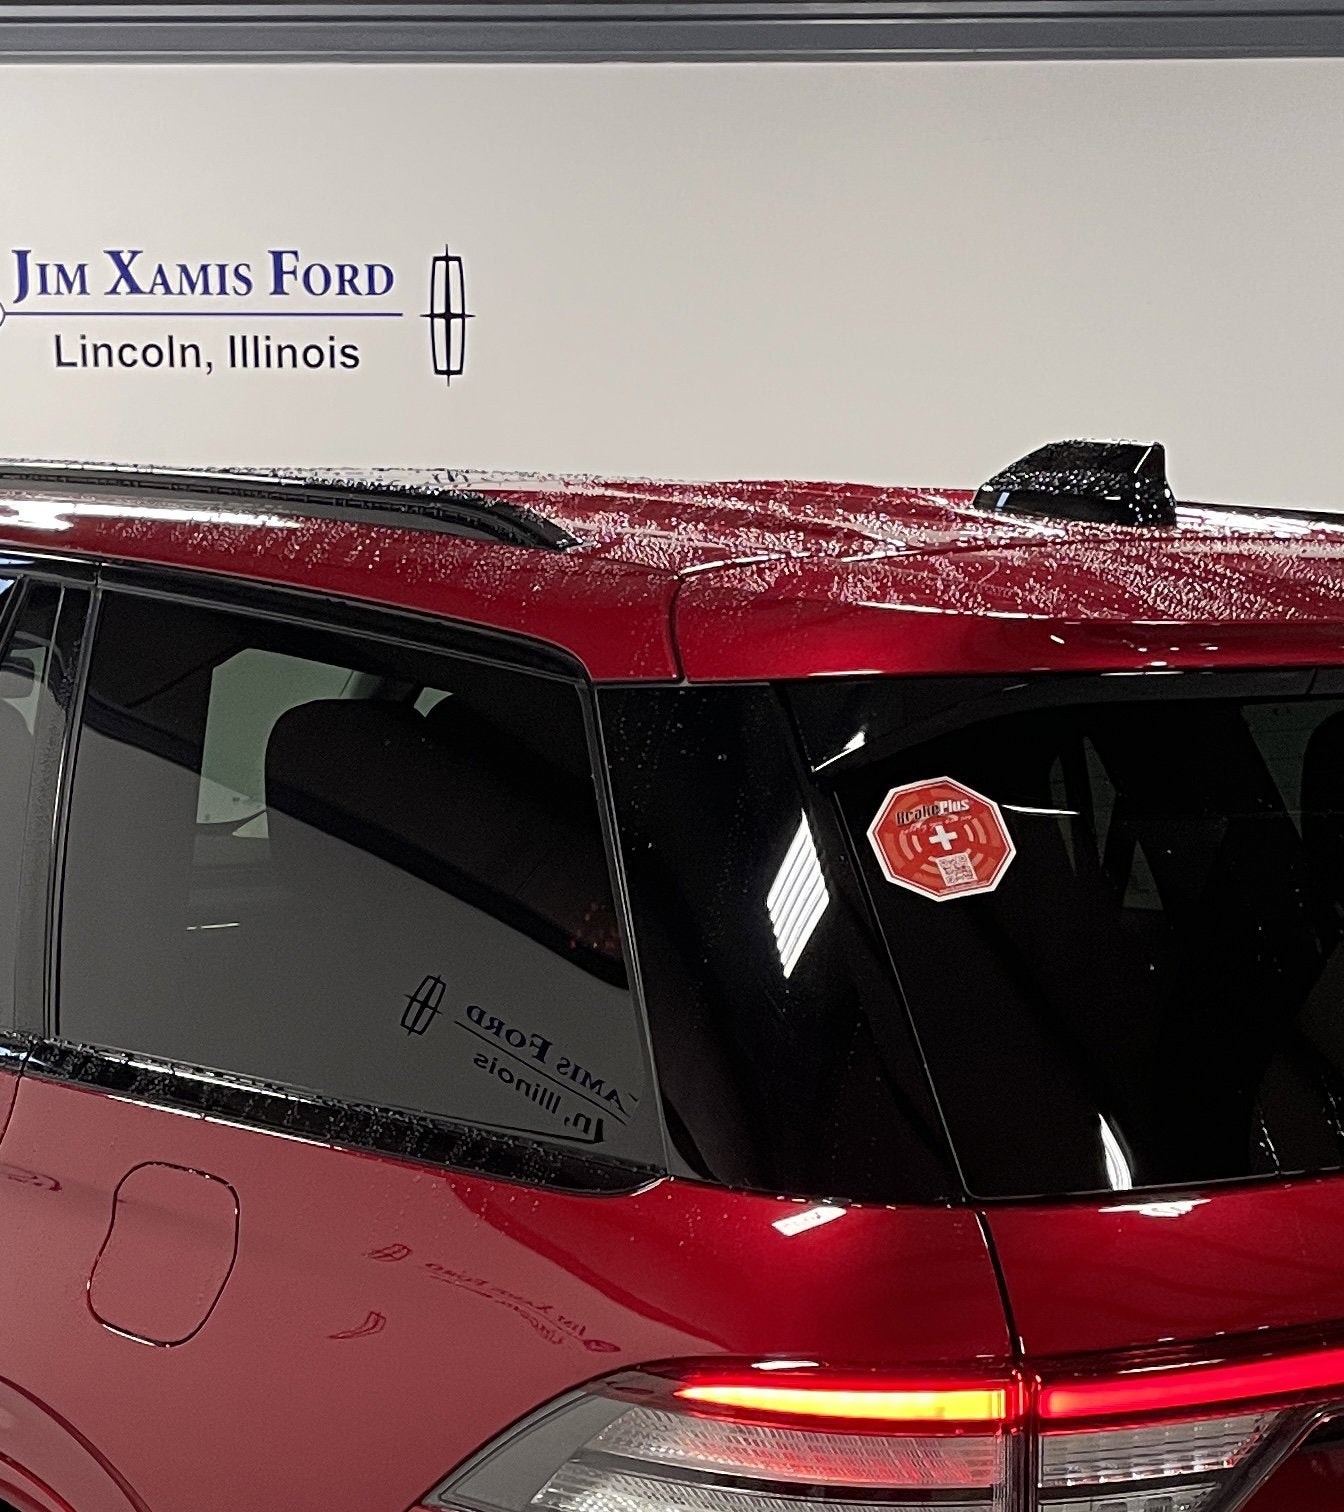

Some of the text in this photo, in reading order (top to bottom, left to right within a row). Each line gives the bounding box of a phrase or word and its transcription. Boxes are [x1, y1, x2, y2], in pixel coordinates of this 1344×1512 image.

[11, 249, 394, 304] JIM XAMIS FORD
[55, 334, 360, 375] Lincoln, Illinois
